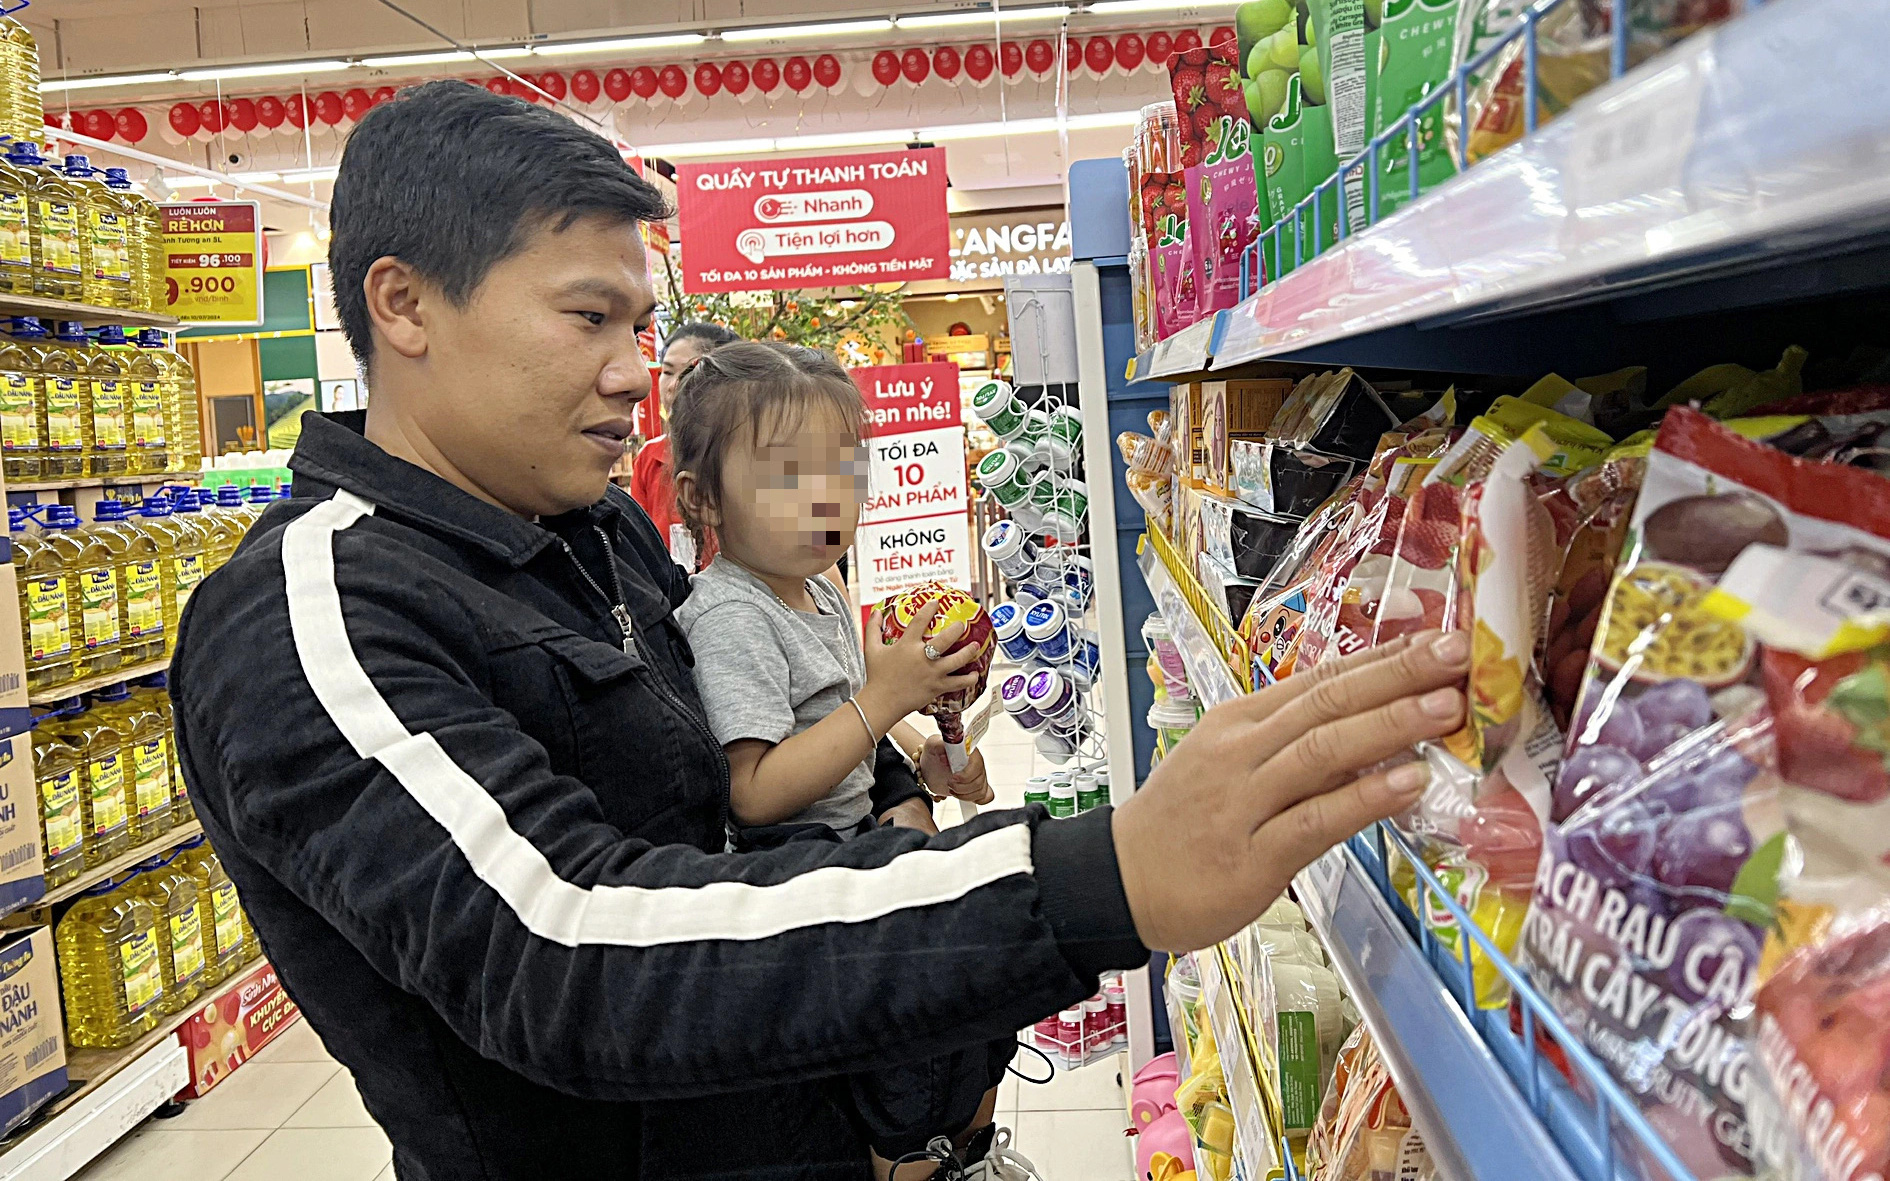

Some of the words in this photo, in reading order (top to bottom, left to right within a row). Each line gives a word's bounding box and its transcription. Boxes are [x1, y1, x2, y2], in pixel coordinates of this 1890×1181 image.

[1205, 115, 1251, 168] Je
[759, 167, 791, 190] TỰ
[792, 164, 865, 186] THANH
[868, 157, 928, 180] TOÁN
[169, 207, 192, 216] LUÔN
[193, 207, 217, 215] LUÔN
[804, 196, 863, 214] Nhanh
[168, 217, 188, 232] RẺ
[190, 218, 224, 232] HƠN
[775, 231, 814, 249] Tiện
[819, 229, 841, 246] lợi
[846, 227, 880, 244] hơn
[700, 268, 721, 283] TỐI
[723, 271, 743, 282] ĐA
[744, 270, 758, 281] 10
[760, 266, 786, 280] SẢN
[787, 262, 823, 279] PHẨM
[832, 262, 878, 276] KHÔNG
[879, 258, 907, 272] TIỀN
[909, 257, 935, 271] MẶT
[980, 256, 1014, 278] SẢN
[1016, 255, 1041, 275] ĐÀ
[1042, 256, 1072, 275] LẠT
[875, 379, 915, 399] Lưu
[920, 376, 934, 399] ý
[906, 402, 952, 424] nhé!
[878, 441, 908, 462] TỐI
[912, 441, 939, 458] ĐA
[893, 463, 925, 488] 10
[865, 490, 901, 511] SẢN
[906, 480, 958, 504] PHẨM
[880, 528, 946, 550] KHÔNG
[872, 551, 914, 573] TIỀN
[918, 547, 956, 568] MẶT
[1031, 609, 1049, 620] XYLITOL
[1006, 677, 1020, 698] XYLITOL
[1596, 887, 1682, 970] RAU
[2, 982, 30, 1012] ĐẬU
[1580, 953, 1661, 1030] CÂY
[0, 1001, 38, 1034] NÀNH
[262, 1008, 282, 1033] CỰC
